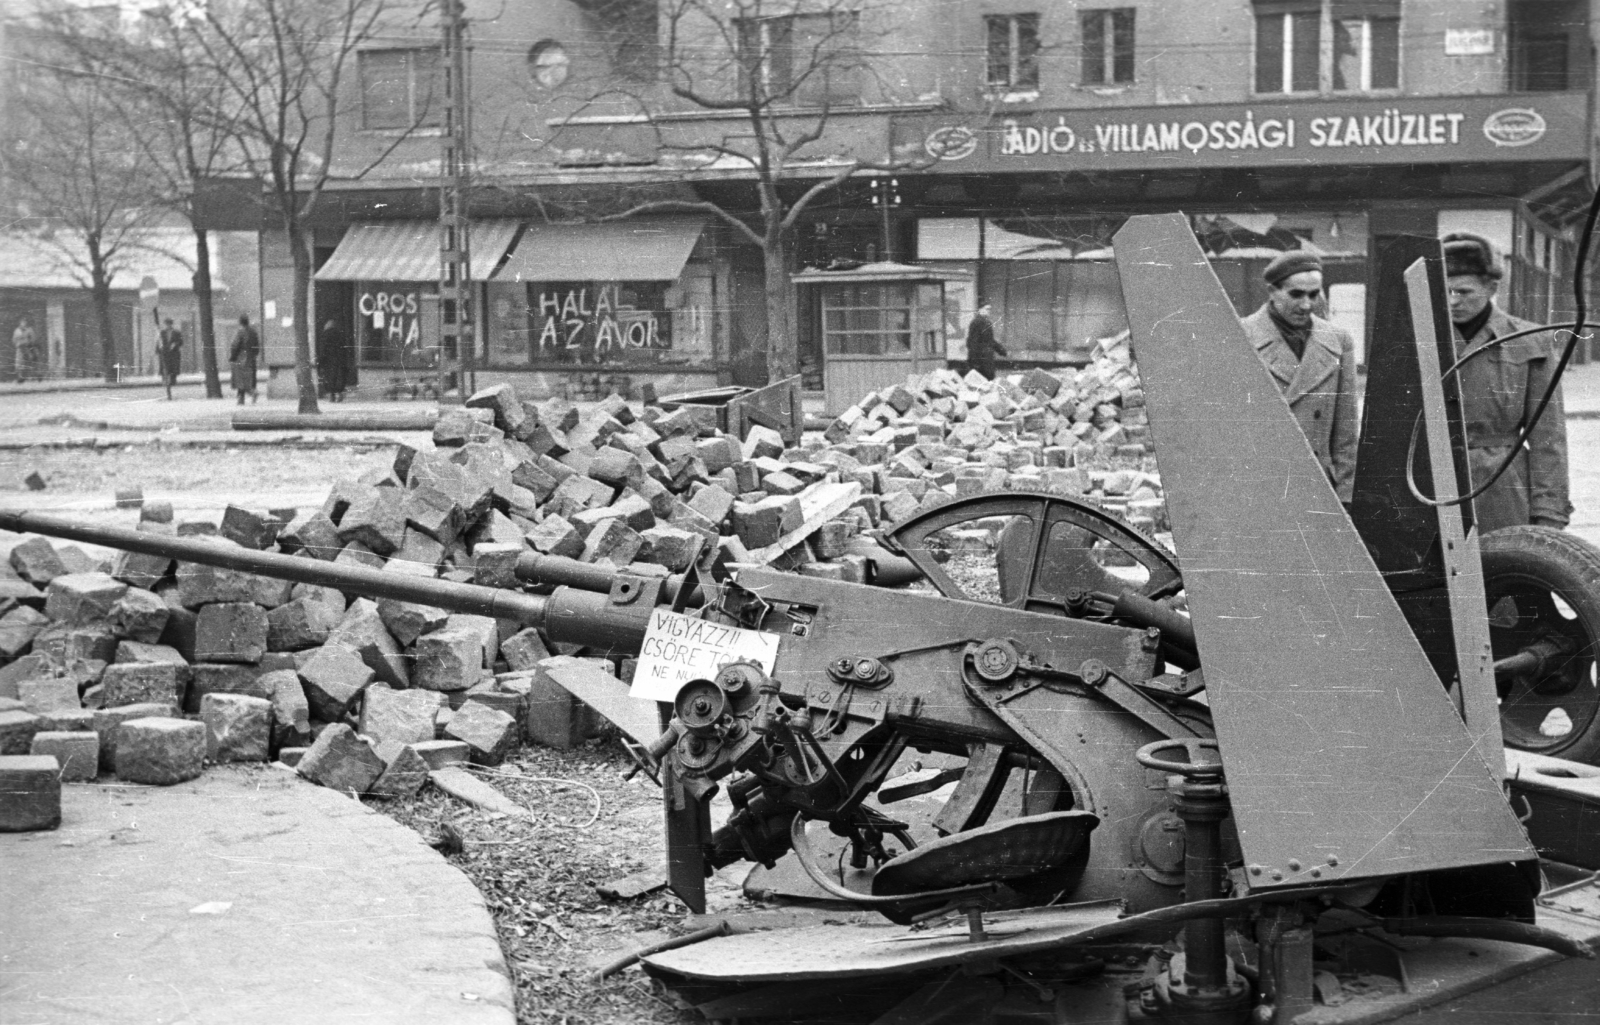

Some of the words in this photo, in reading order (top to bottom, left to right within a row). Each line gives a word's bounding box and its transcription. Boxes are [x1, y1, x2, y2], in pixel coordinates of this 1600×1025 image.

[1095, 110, 1294, 152] VILLAMOSSÁGI
[1309, 109, 1465, 147] SZAKÜZLET
[539, 316, 585, 350] AZ
[651, 664, 670, 679] NE
